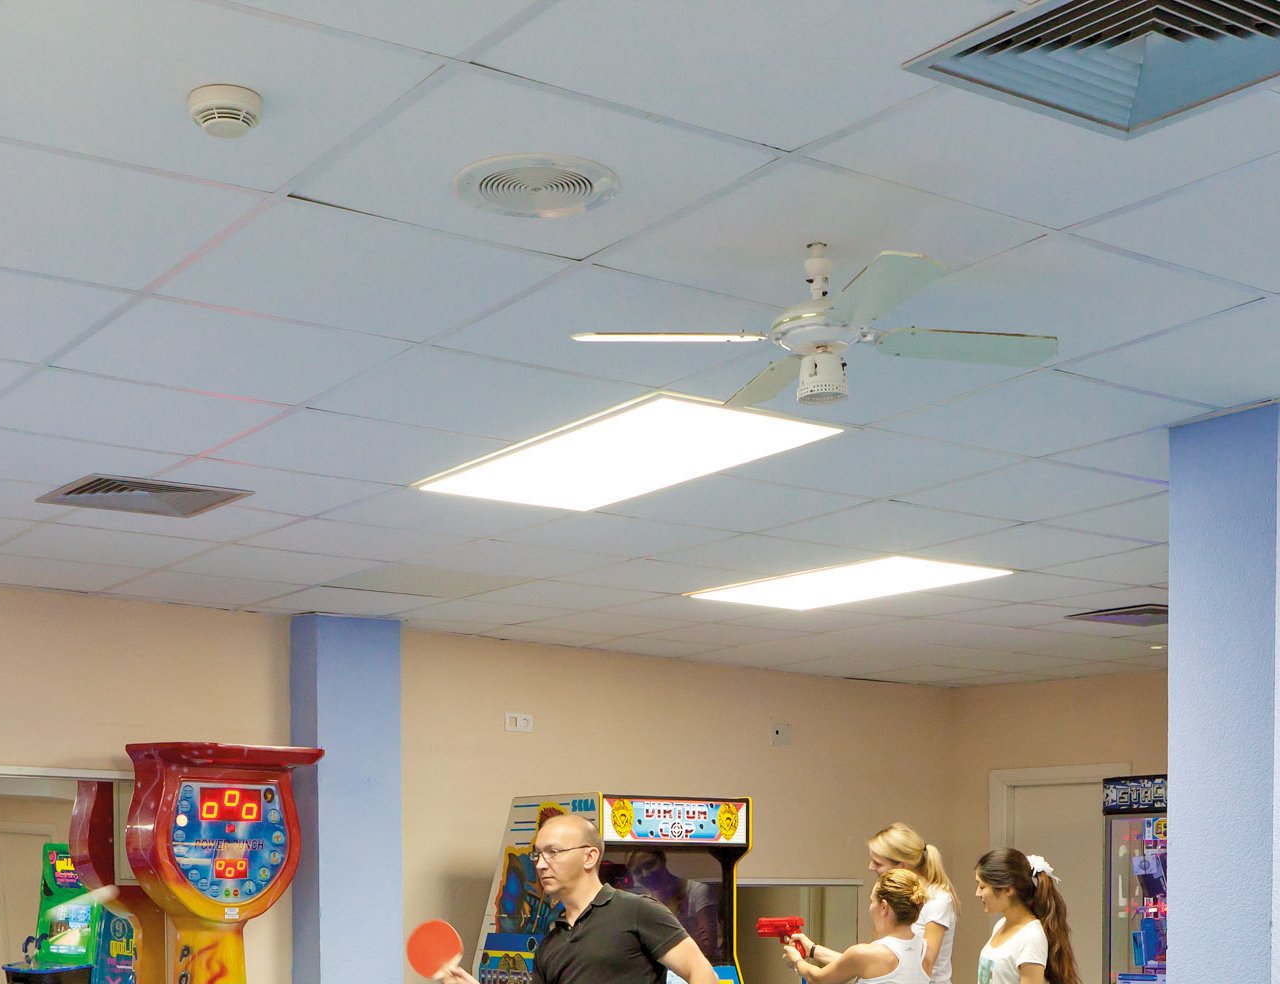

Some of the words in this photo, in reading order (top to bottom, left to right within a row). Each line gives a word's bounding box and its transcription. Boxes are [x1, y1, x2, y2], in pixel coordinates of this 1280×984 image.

[1117, 784, 1167, 805] STAC
[572, 798, 596, 812] SEGA
[644, 801, 708, 820] VIRTUA
[194, 839, 230, 851] POWER
